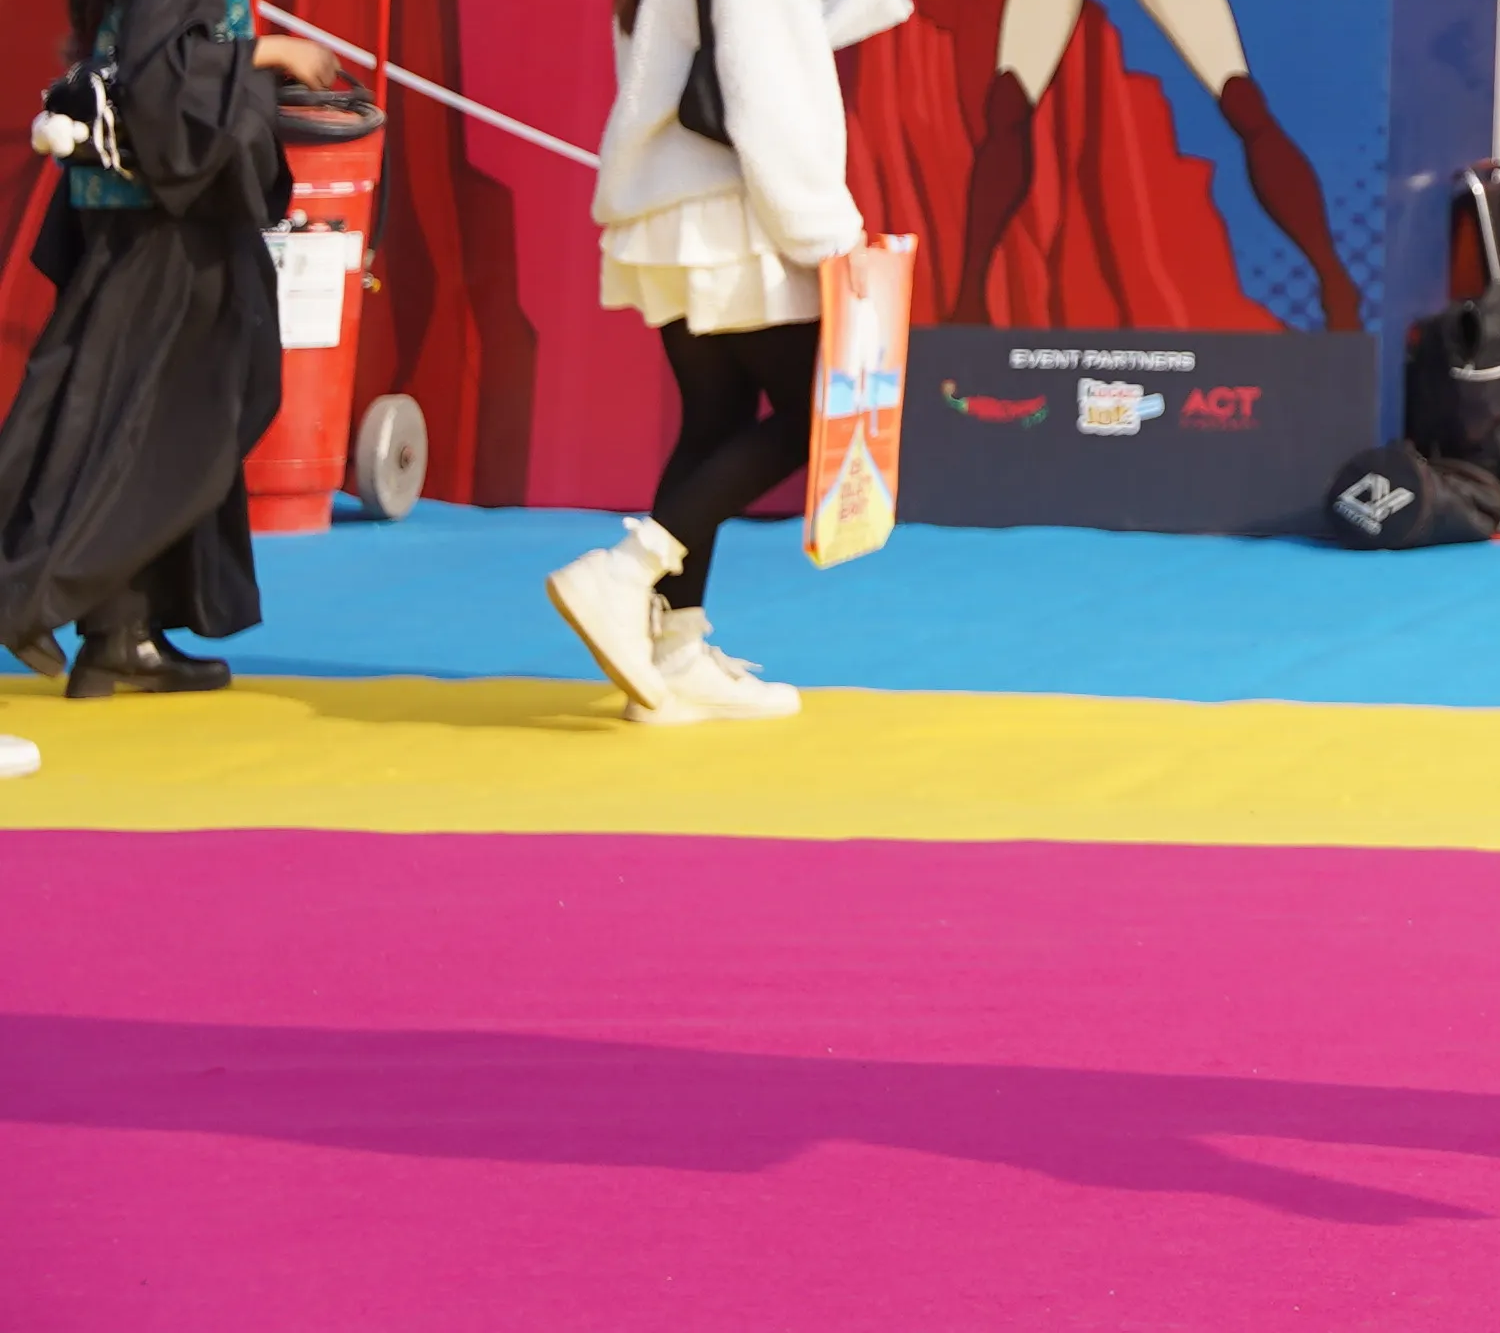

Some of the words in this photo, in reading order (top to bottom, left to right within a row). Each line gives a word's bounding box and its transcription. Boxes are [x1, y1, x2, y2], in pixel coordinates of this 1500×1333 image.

[1009, 348, 1082, 370] EVENT
[1083, 350, 1196, 372] PARTNERS
[1181, 385, 1262, 418] ACT
